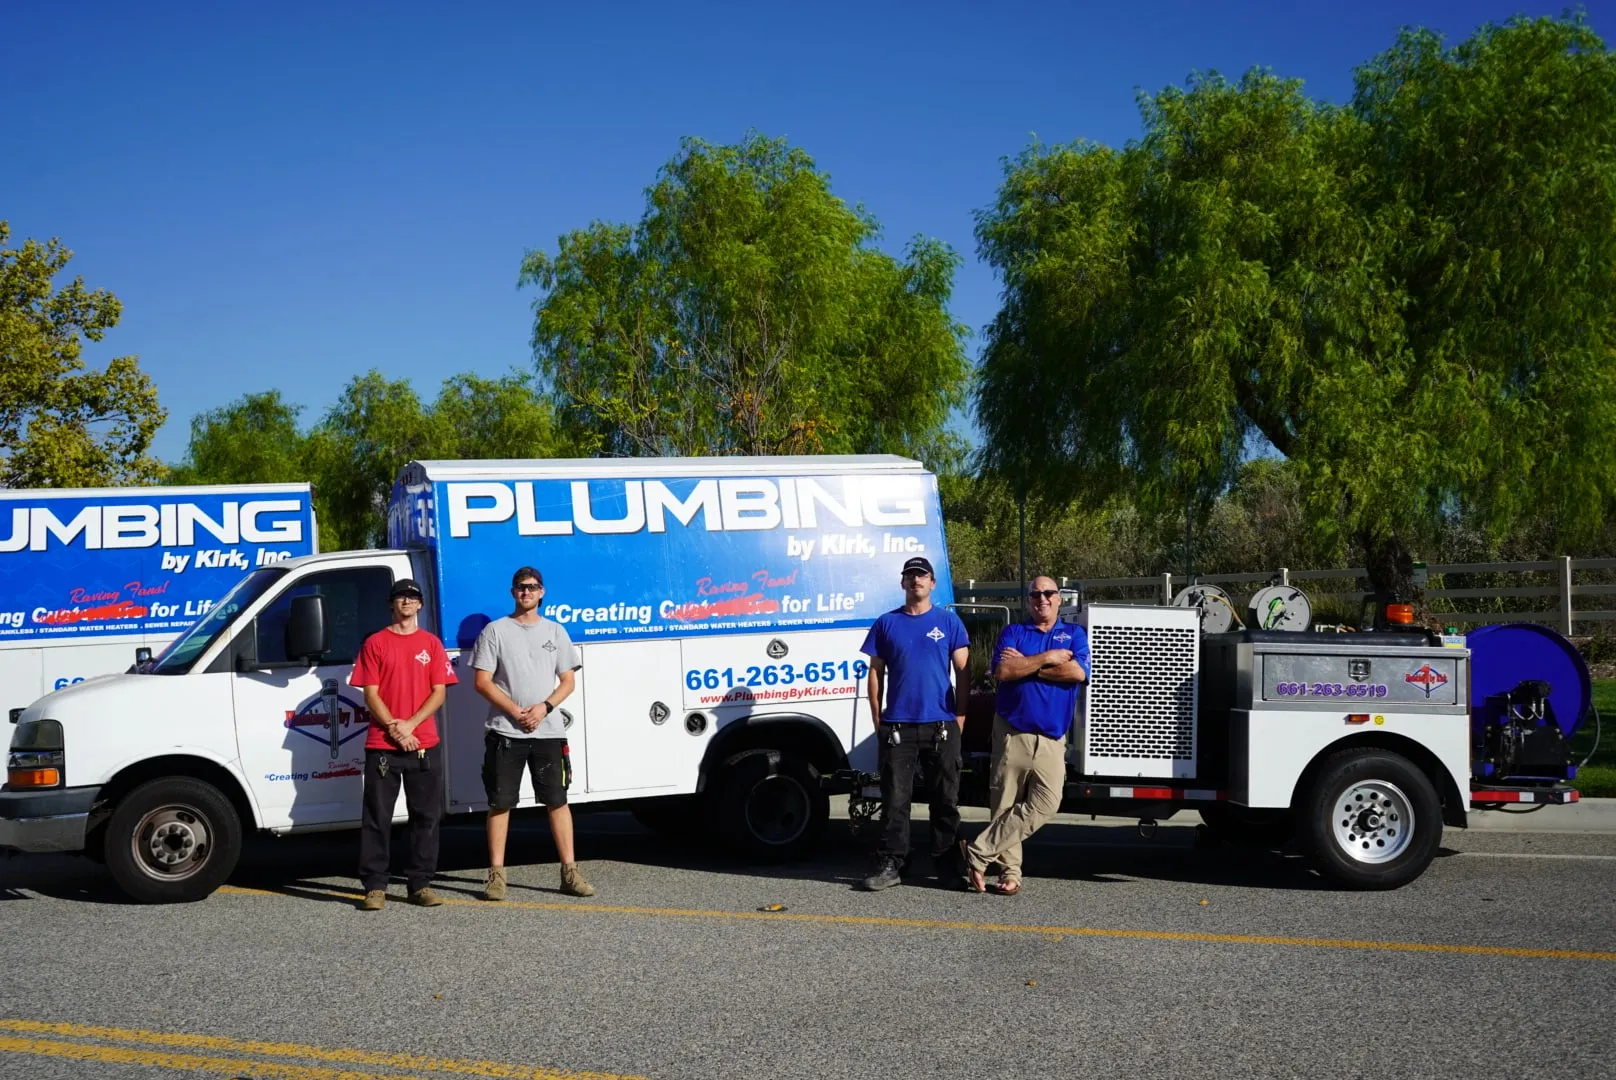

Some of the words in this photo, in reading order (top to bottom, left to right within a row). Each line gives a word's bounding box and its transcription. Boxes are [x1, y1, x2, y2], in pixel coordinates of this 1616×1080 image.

[447, 475, 927, 538] PLUMBING
[787, 535, 815, 560] by
[883, 532, 925, 553] Inc.
[161, 551, 190, 573] by
[70, 588, 120, 604] Raving
[782, 595, 811, 613] for
[150, 602, 179, 618] for
[79, 624, 104, 632] WATER
[106, 622, 138, 630] HEATERS
[584, 628, 618, 636] REPIPES
[624, 625, 663, 633] TANKLESS
[669, 623, 709, 631] STANDARD
[710, 621, 736, 629] WATER
[738, 620, 771, 628] HEATERS
[778, 618, 803, 626] SEWER
[686, 659, 868, 690] 661-263-6519
[700, 686, 856, 703] www.PlumbingByKirk.com
[1276, 682, 1388, 697] 661-263-6519
